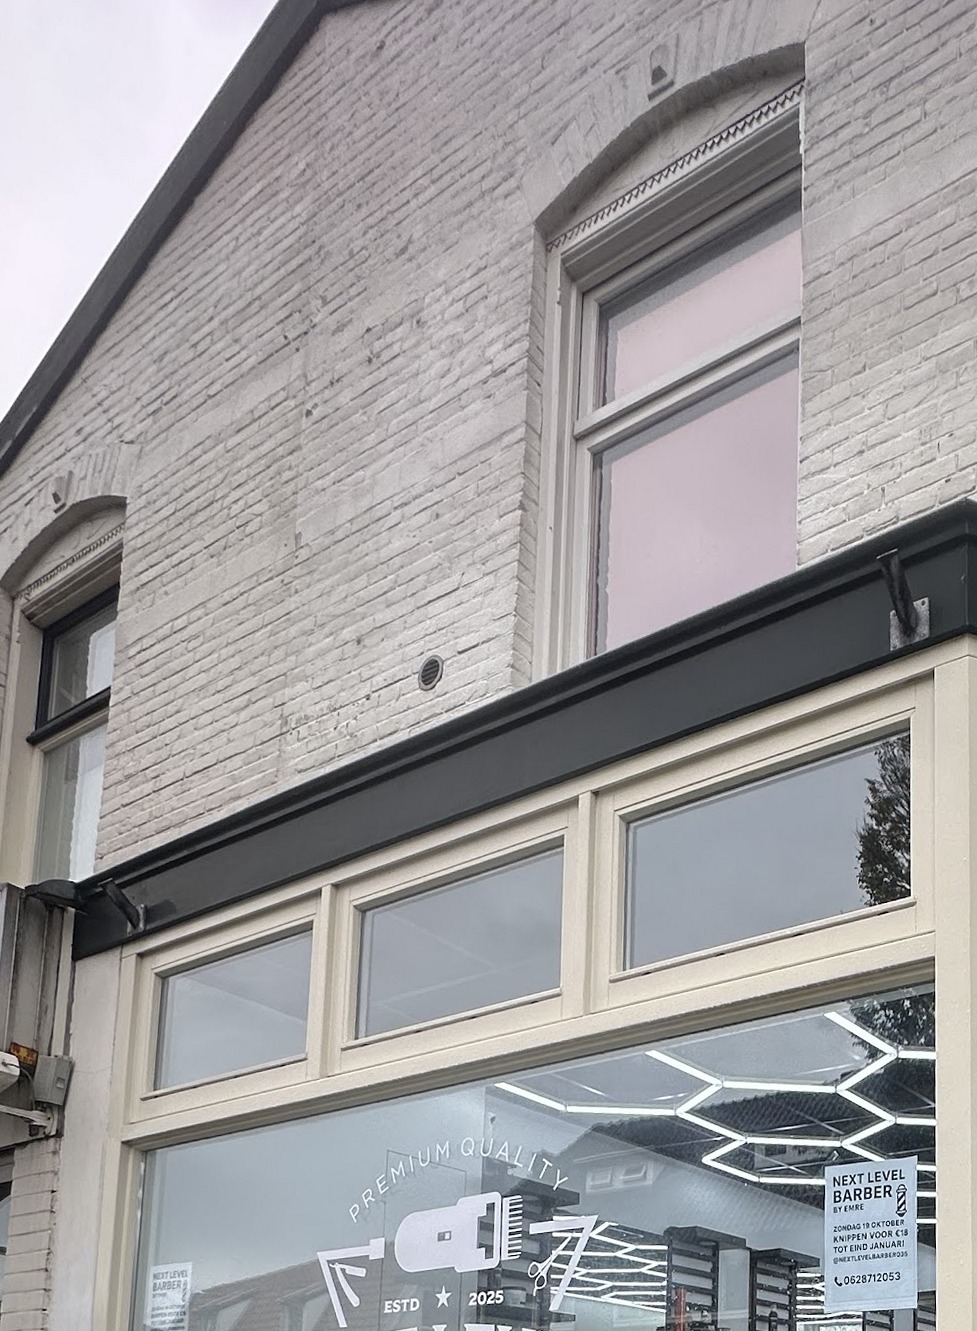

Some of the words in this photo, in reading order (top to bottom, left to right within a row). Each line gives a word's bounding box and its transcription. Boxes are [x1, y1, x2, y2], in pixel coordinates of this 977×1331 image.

[348, 1139, 450, 1223] PREMIUM
[460, 1136, 569, 1191] QUALITY
[833, 1173, 864, 1187] NEXT
[867, 1169, 905, 1183] LEVEL
[833, 1185, 893, 1203] BARBER
[844, 1203, 864, 1212] EMRE
[833, 1223, 861, 1232] ZONDAG
[871, 1219, 905, 1228] OKTOBER
[833, 1232, 868, 1243] KNIPPEN
[869, 1230, 893, 1239] VOOR
[833, 1245, 848, 1253] TOT
[849, 1243, 868, 1252] EIND
[869, 1240, 905, 1250] JANUARI
[383, 1298, 421, 1314] ESTD
[468, 1290, 504, 1306] 2025
